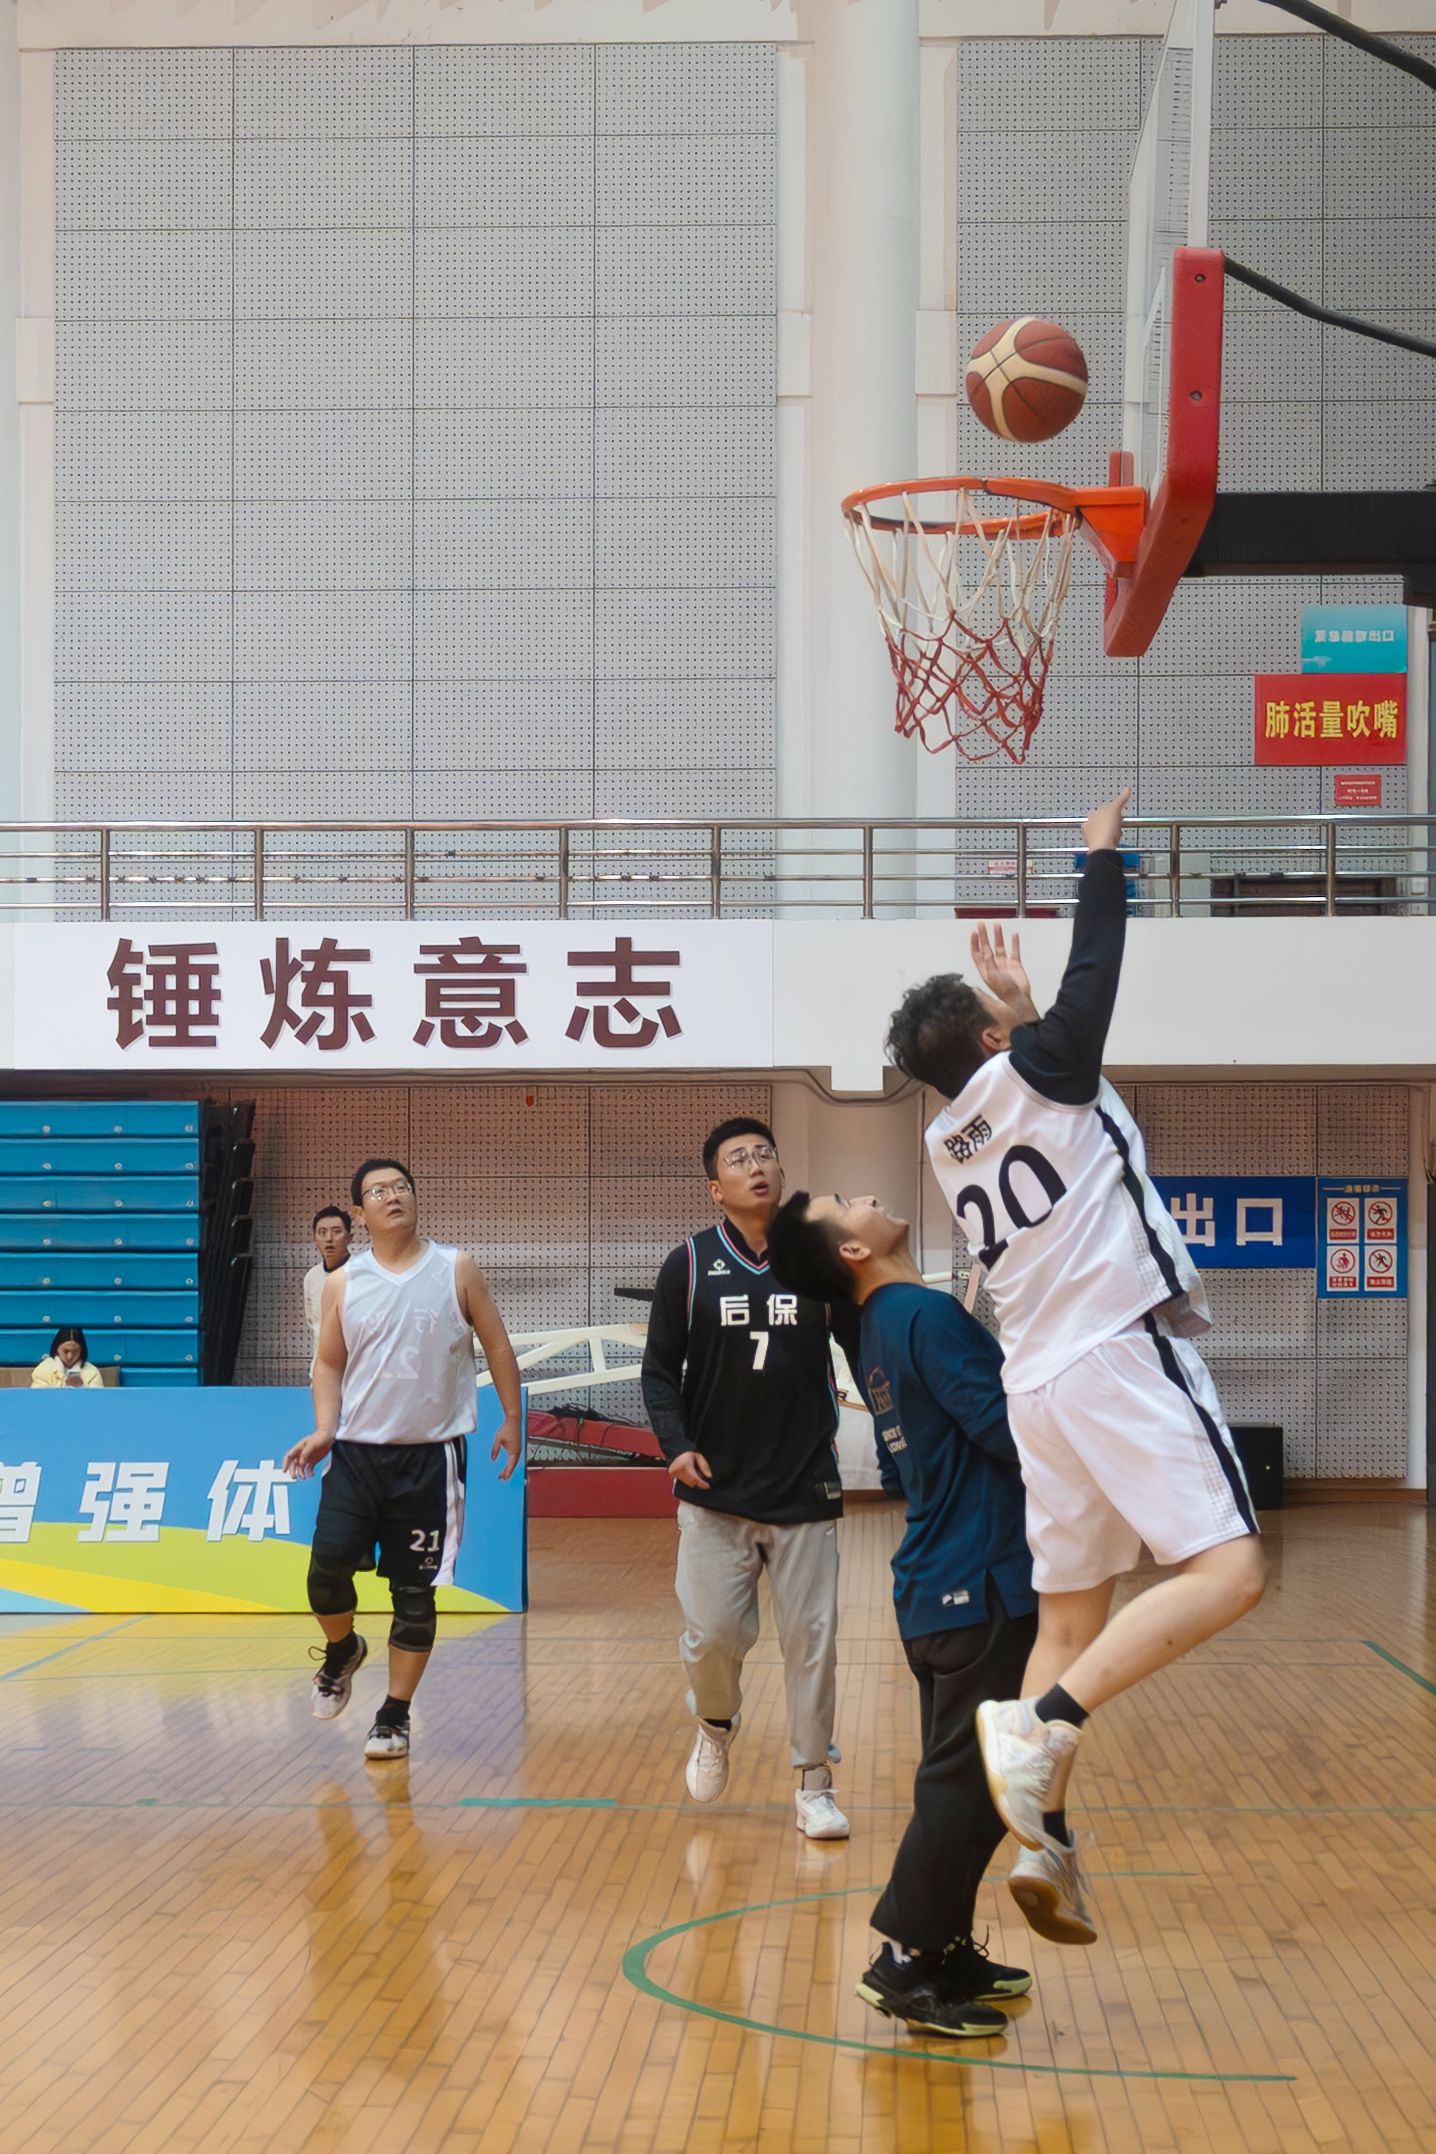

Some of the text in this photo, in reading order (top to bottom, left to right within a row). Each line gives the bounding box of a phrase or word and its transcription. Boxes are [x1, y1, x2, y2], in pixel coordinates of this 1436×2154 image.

[1265, 700, 1398, 739] 肺活量吹嘴
[106, 936, 682, 1051] 锤炼意志
[957, 1144, 1068, 1271] 20
[1170, 1192, 1283, 1247] 出口
[719, 1293, 799, 1327] 后保
[749, 1331, 769, 1371] 7
[409, 1529, 440, 1552] 21
